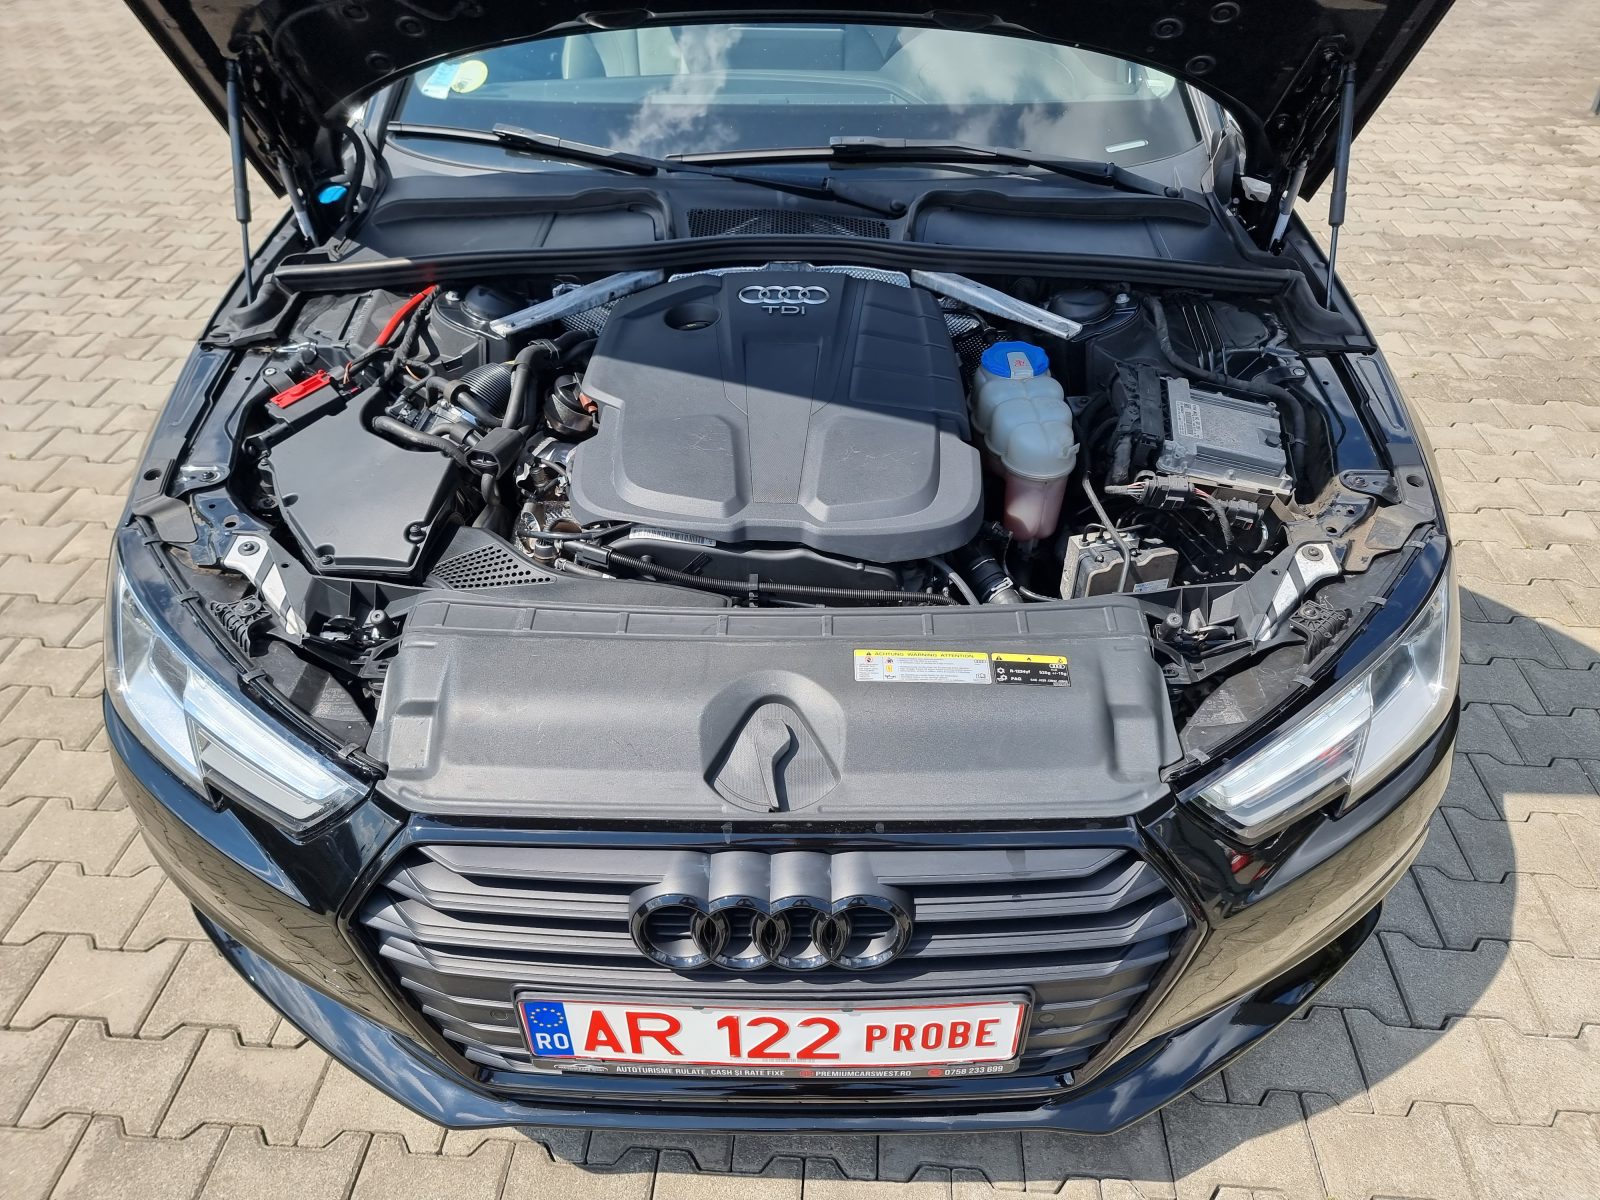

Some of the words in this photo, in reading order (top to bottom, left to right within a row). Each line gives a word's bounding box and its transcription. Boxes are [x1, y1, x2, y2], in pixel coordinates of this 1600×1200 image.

[761, 305, 805, 315] TDI
[584, 1010, 684, 1056] AR
[716, 1015, 840, 1060] 122
[864, 1018, 1000, 1053] PROBE
[535, 1032, 570, 1050] RO
[616, 1066, 673, 1074] AUTOTURISME
[675, 1068, 709, 1076] RULATE,
[986, 1065, 1004, 1073] 699
